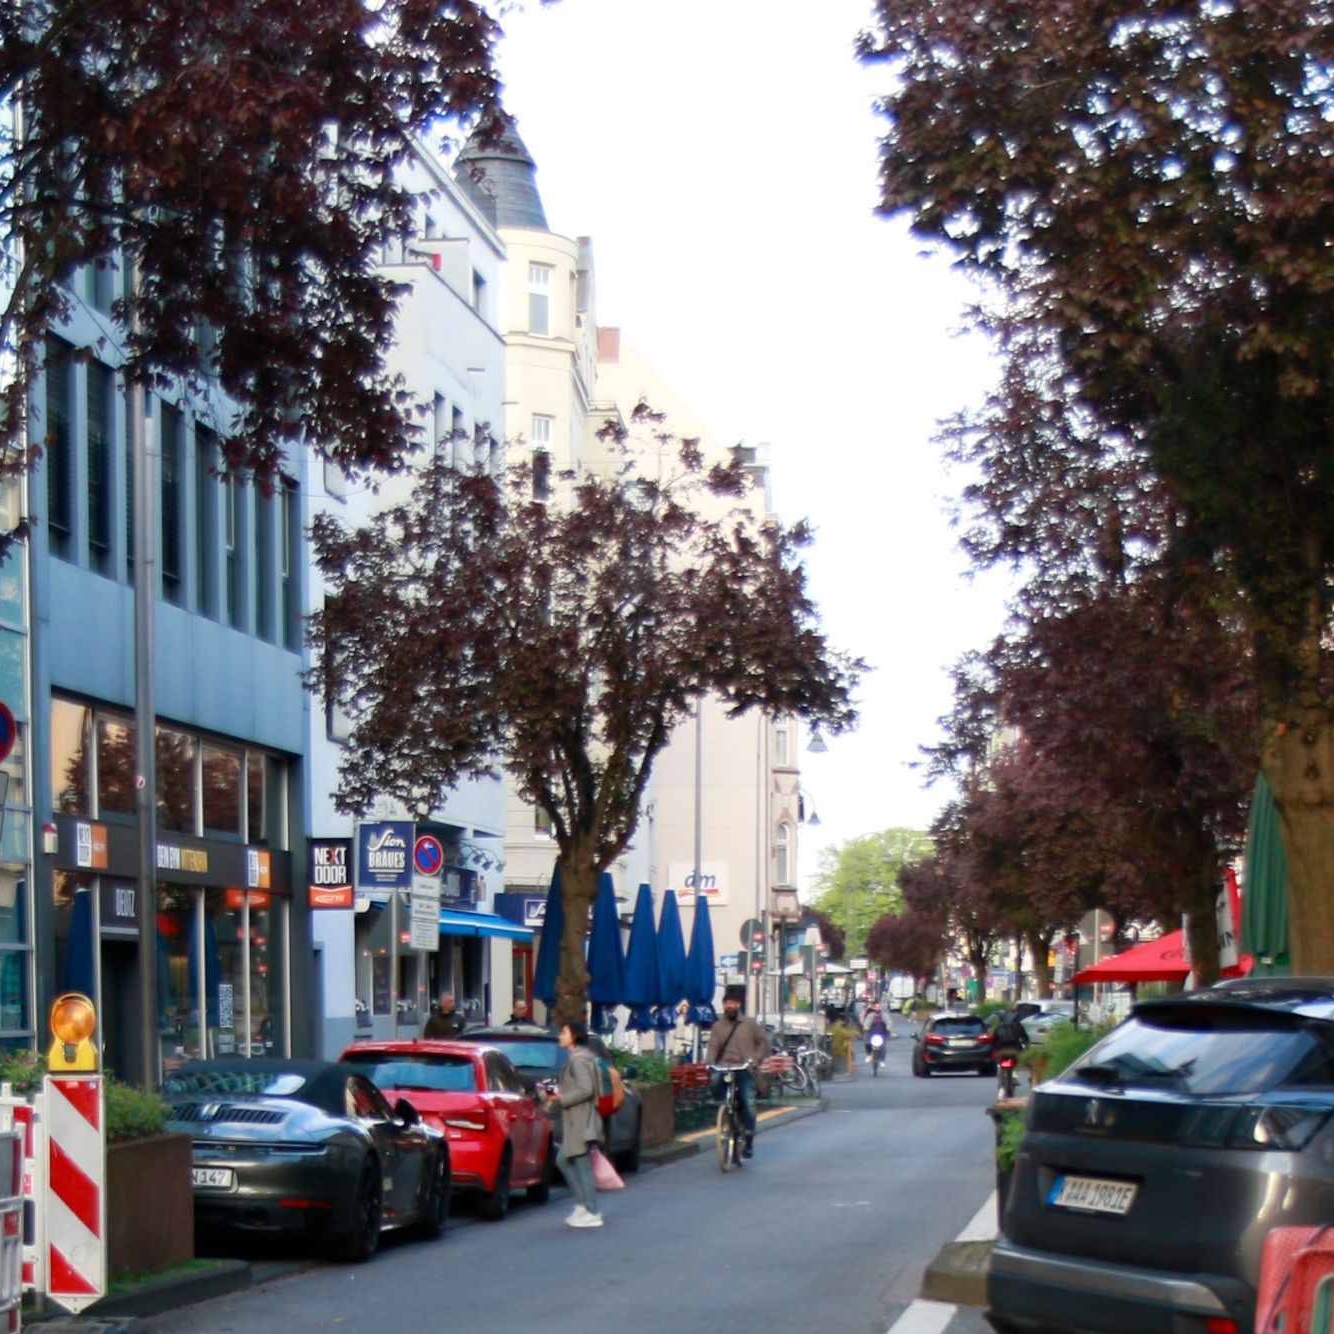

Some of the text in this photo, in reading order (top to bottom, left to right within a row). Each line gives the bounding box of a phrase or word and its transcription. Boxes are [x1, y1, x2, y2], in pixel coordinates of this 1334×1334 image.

[367, 829, 406, 851] Sion
[314, 847, 347, 865] NEXT
[314, 866, 347, 885] DOOR
[684, 869, 716, 888] dm
[200, 1170, 227, 1185] 147
